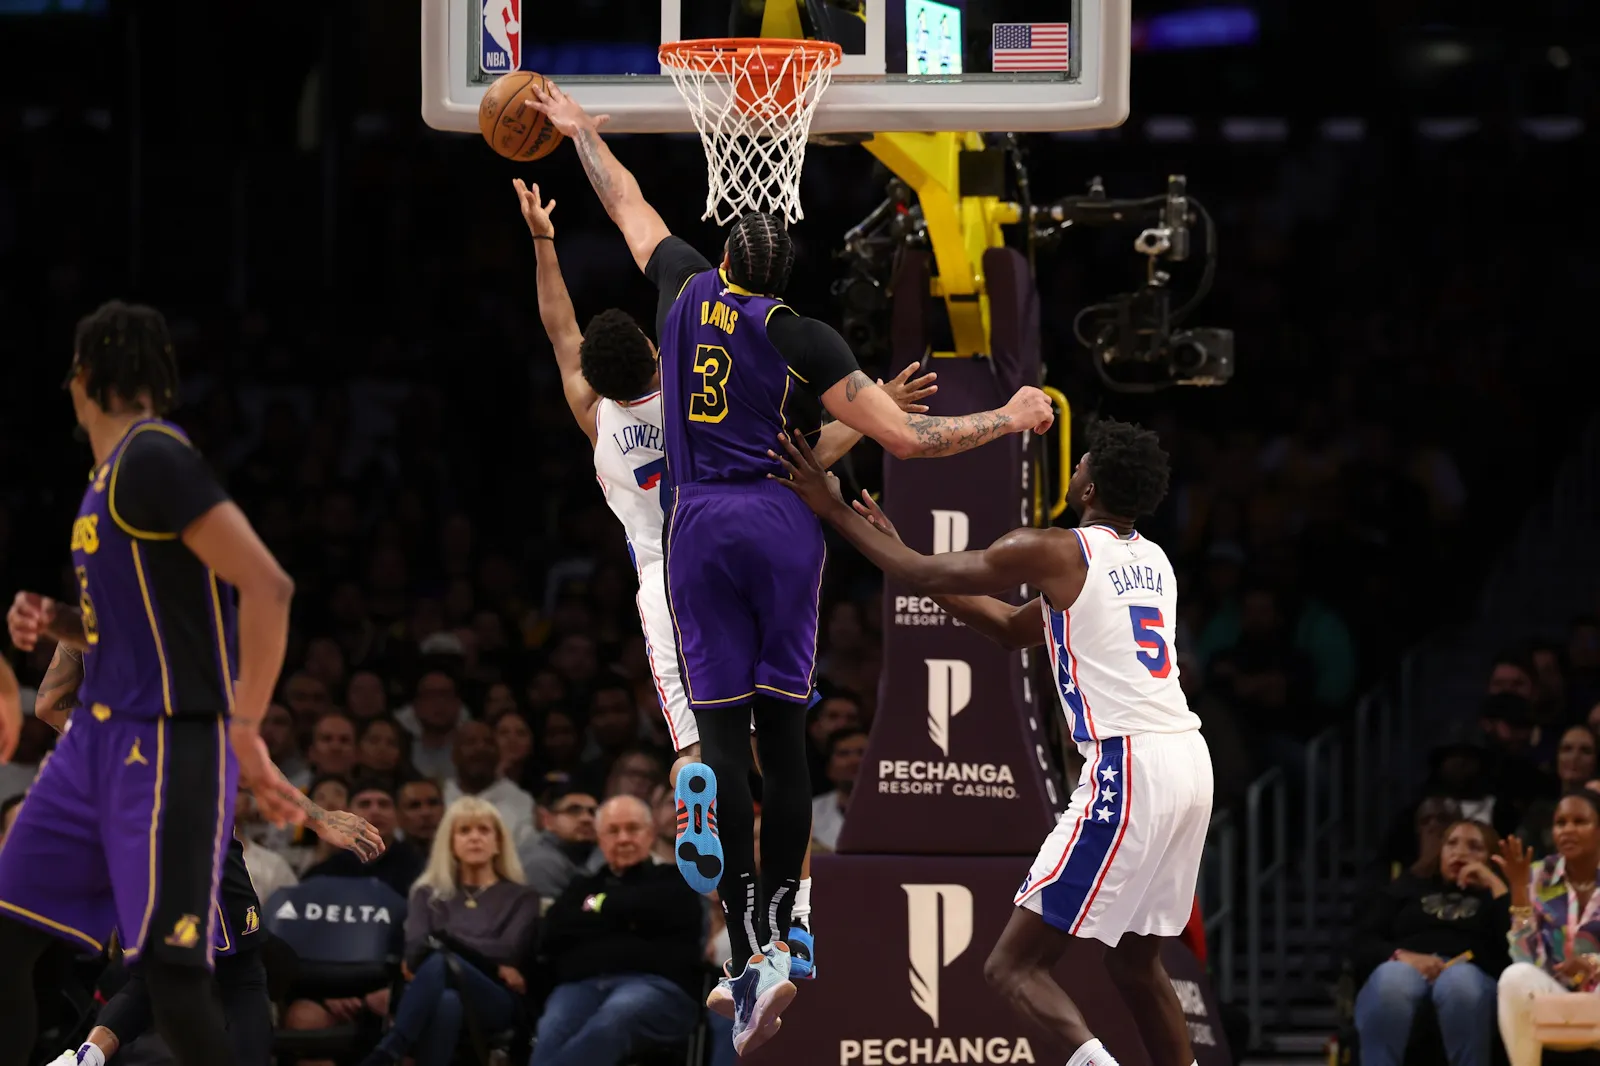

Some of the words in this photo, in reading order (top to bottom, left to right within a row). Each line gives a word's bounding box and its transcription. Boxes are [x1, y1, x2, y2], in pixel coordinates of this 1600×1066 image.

[486, 51, 506, 68] NBA
[688, 343, 733, 424] 3
[1108, 565, 1164, 596] BAMBA
[895, 613, 946, 626] RESORT
[1128, 605, 1172, 679] 5
[879, 760, 1015, 785] PECHANGA
[878, 781, 945, 795] RESORT
[304, 902, 391, 924] DELTA
[840, 1037, 1036, 1066] PECHANGA
